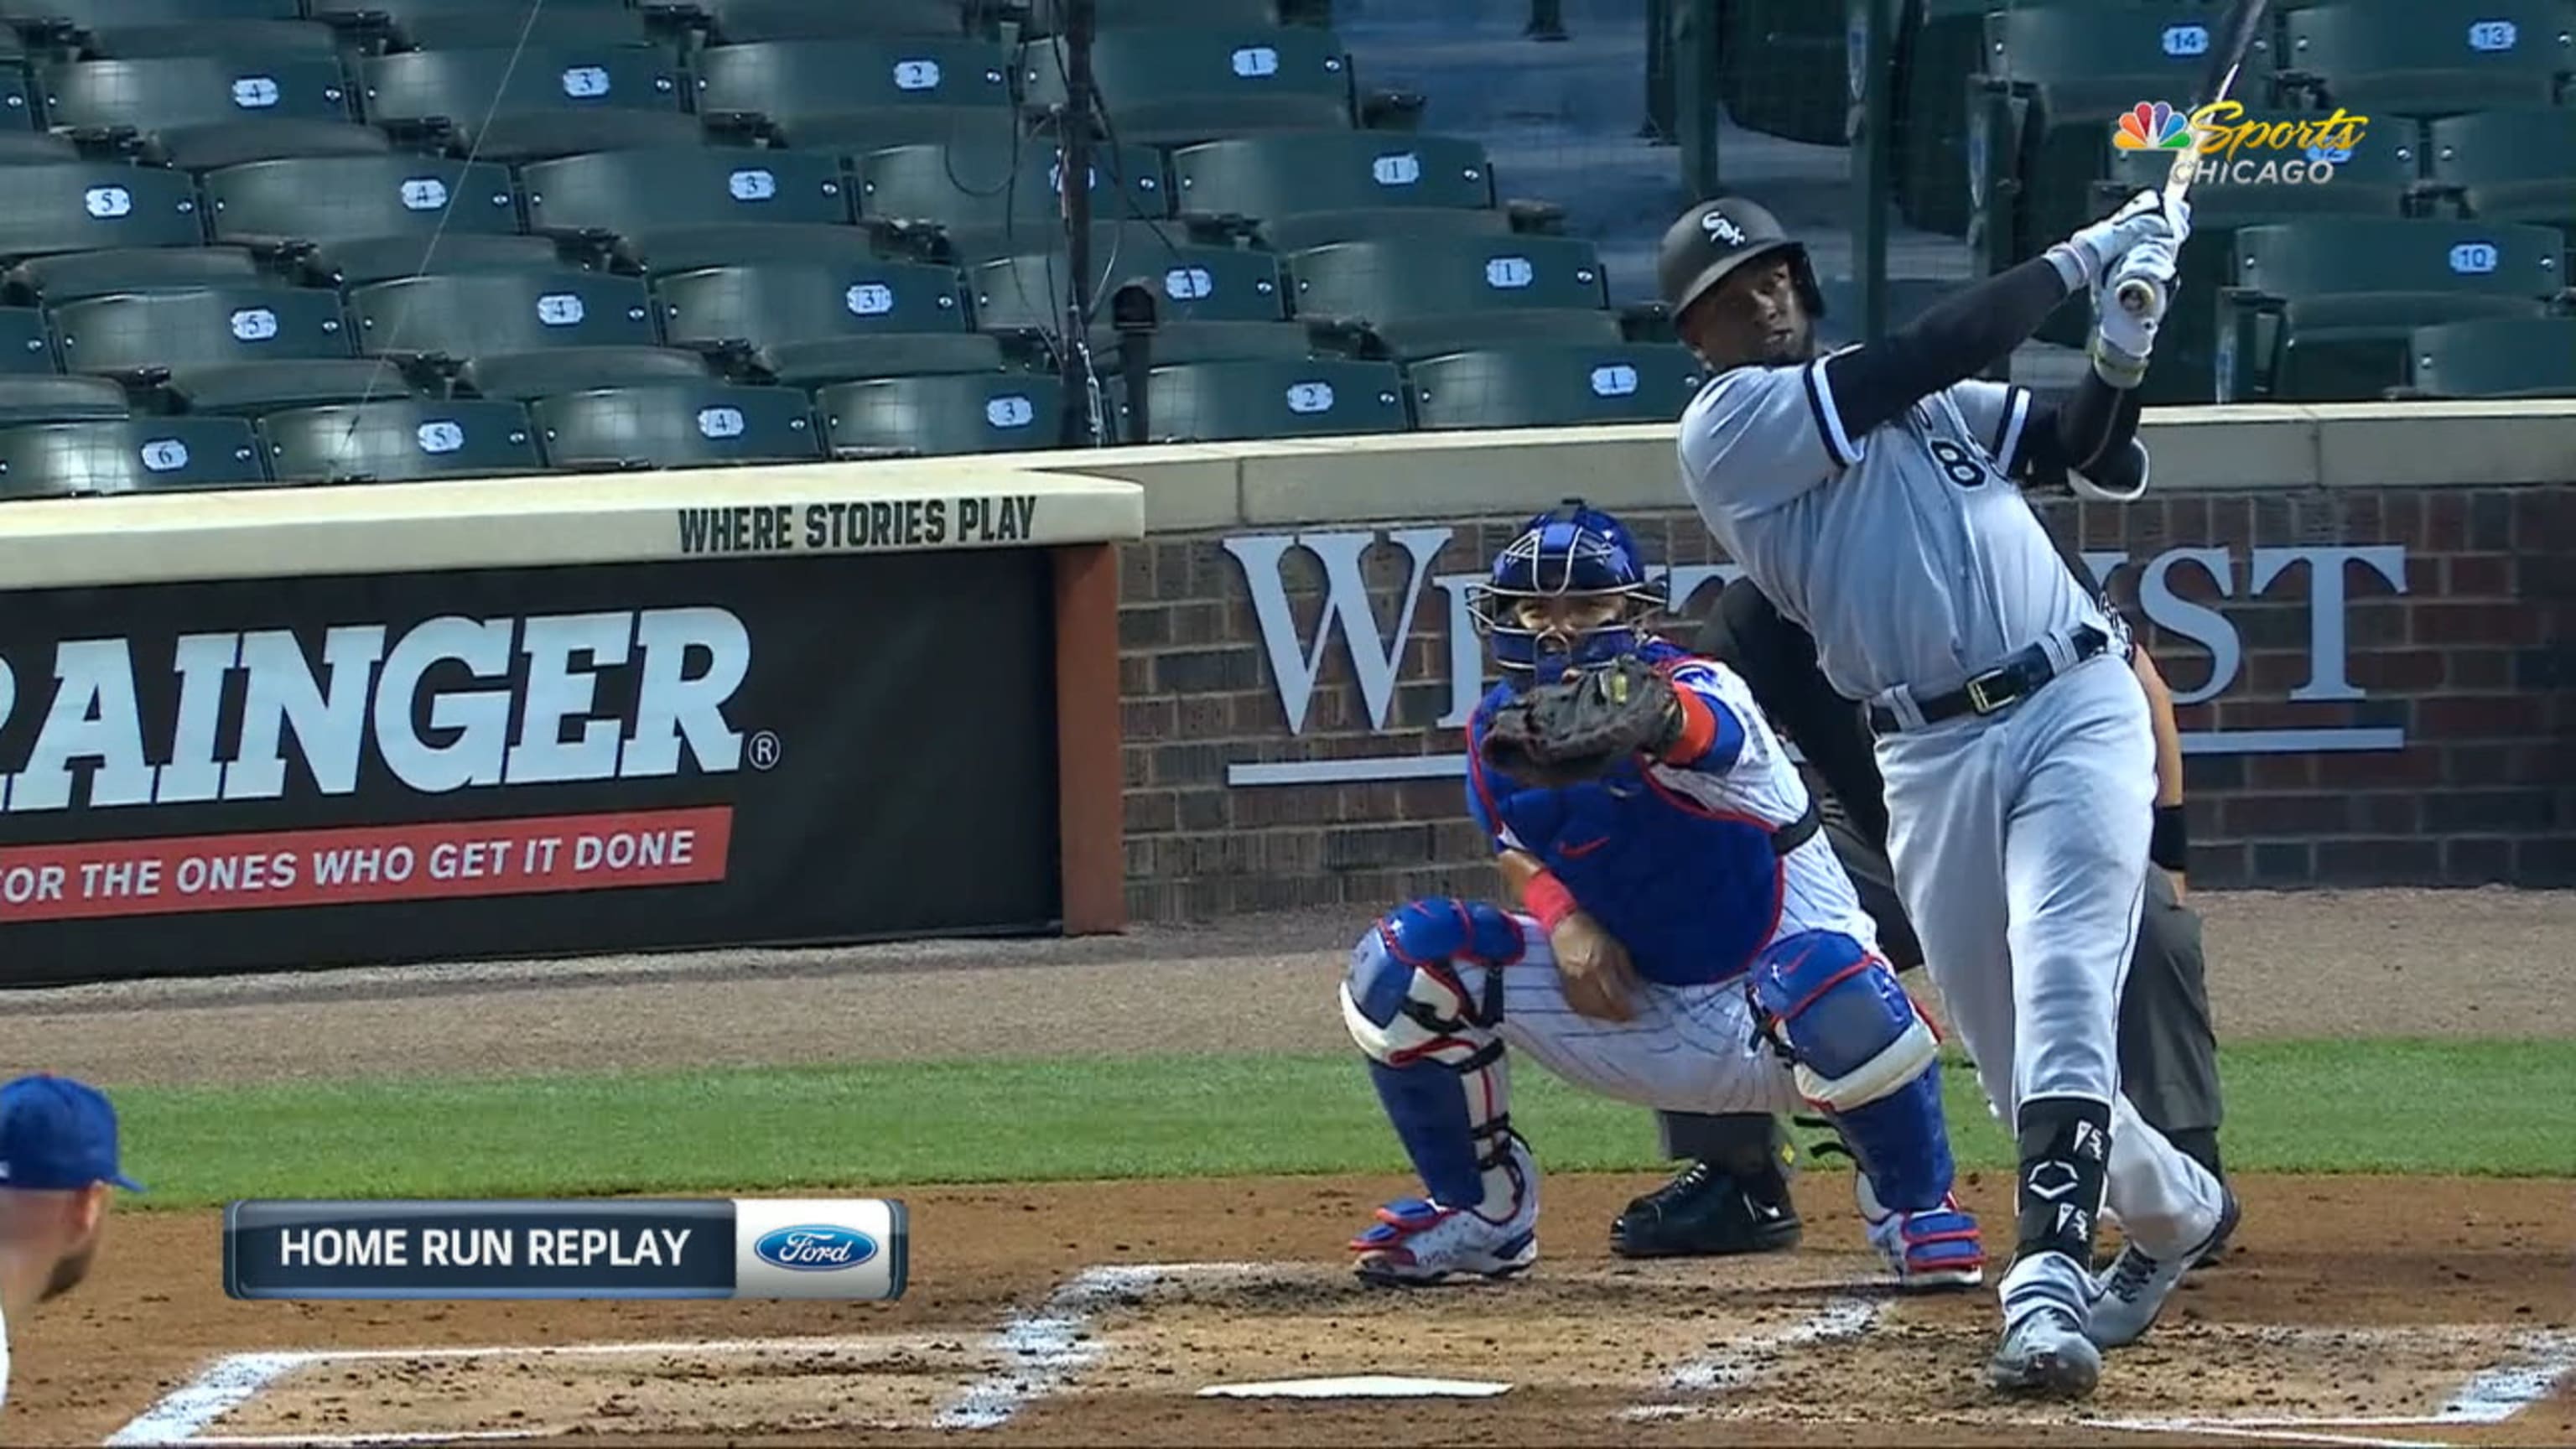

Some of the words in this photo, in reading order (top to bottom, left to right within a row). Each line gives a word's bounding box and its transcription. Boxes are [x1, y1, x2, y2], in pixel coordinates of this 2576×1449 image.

[1929, 434, 2007, 491] 8
[678, 505, 793, 553] WHERE
[805, 499, 946, 548] STORIES
[958, 495, 1038, 542] PLAY
[0, 605, 751, 812] AINGER
[0, 865, 66, 903] OR
[80, 859, 163, 899] THE
[176, 852, 298, 894] ONES
[313, 845, 415, 886] WHO
[429, 840, 512, 880] GET
[524, 838, 563, 875] IT
[574, 829, 696, 871] DONE
